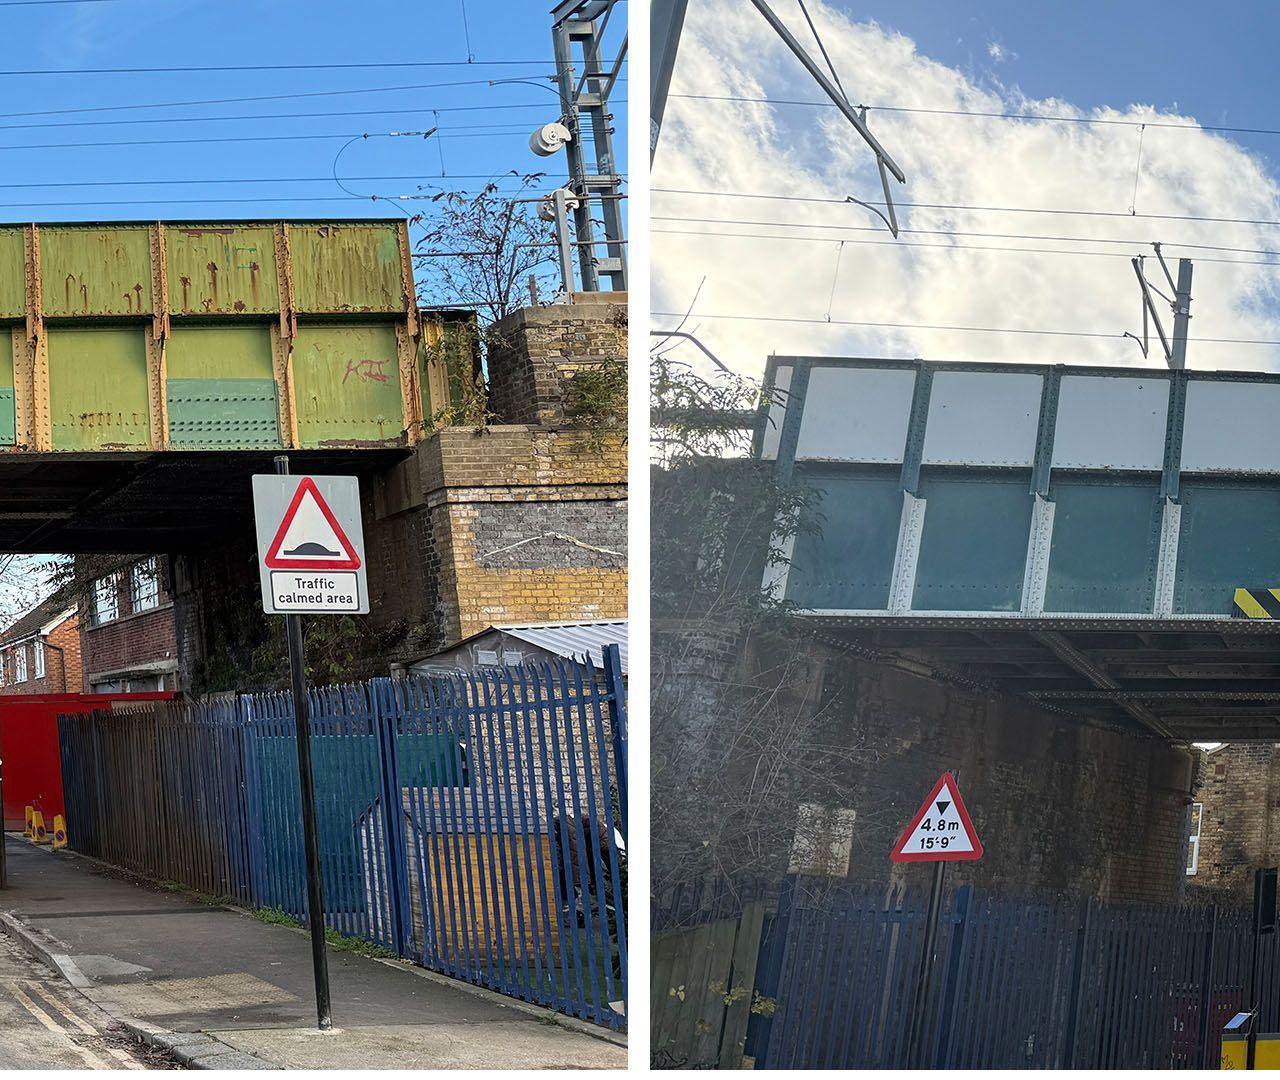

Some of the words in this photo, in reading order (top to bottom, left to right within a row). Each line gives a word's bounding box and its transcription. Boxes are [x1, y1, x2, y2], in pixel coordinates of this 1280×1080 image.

[295, 578, 335, 589] Traffic
[279, 592, 323, 604] calmed
[327, 594, 353, 604] area
